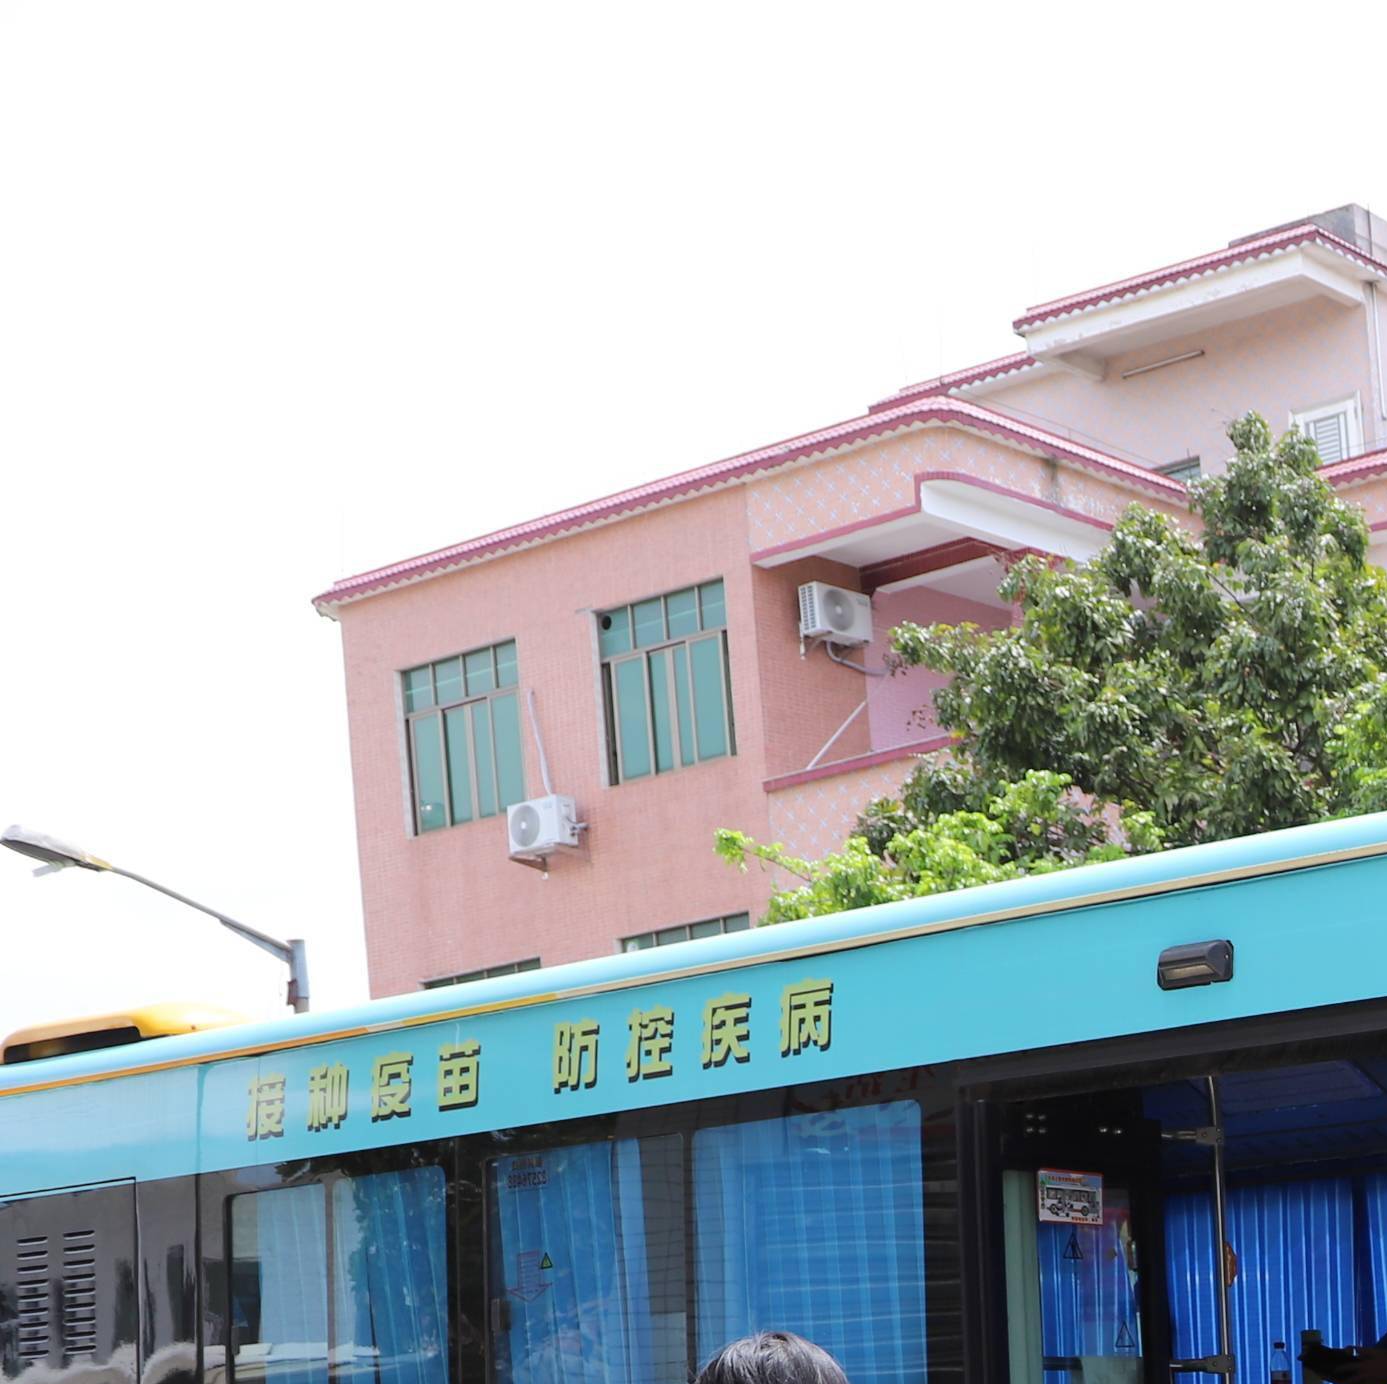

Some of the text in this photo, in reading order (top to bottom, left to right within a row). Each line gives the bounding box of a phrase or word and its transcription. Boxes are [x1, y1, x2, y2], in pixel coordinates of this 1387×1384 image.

[246, 978, 834, 1141] 接种疫苗 防控疾病
